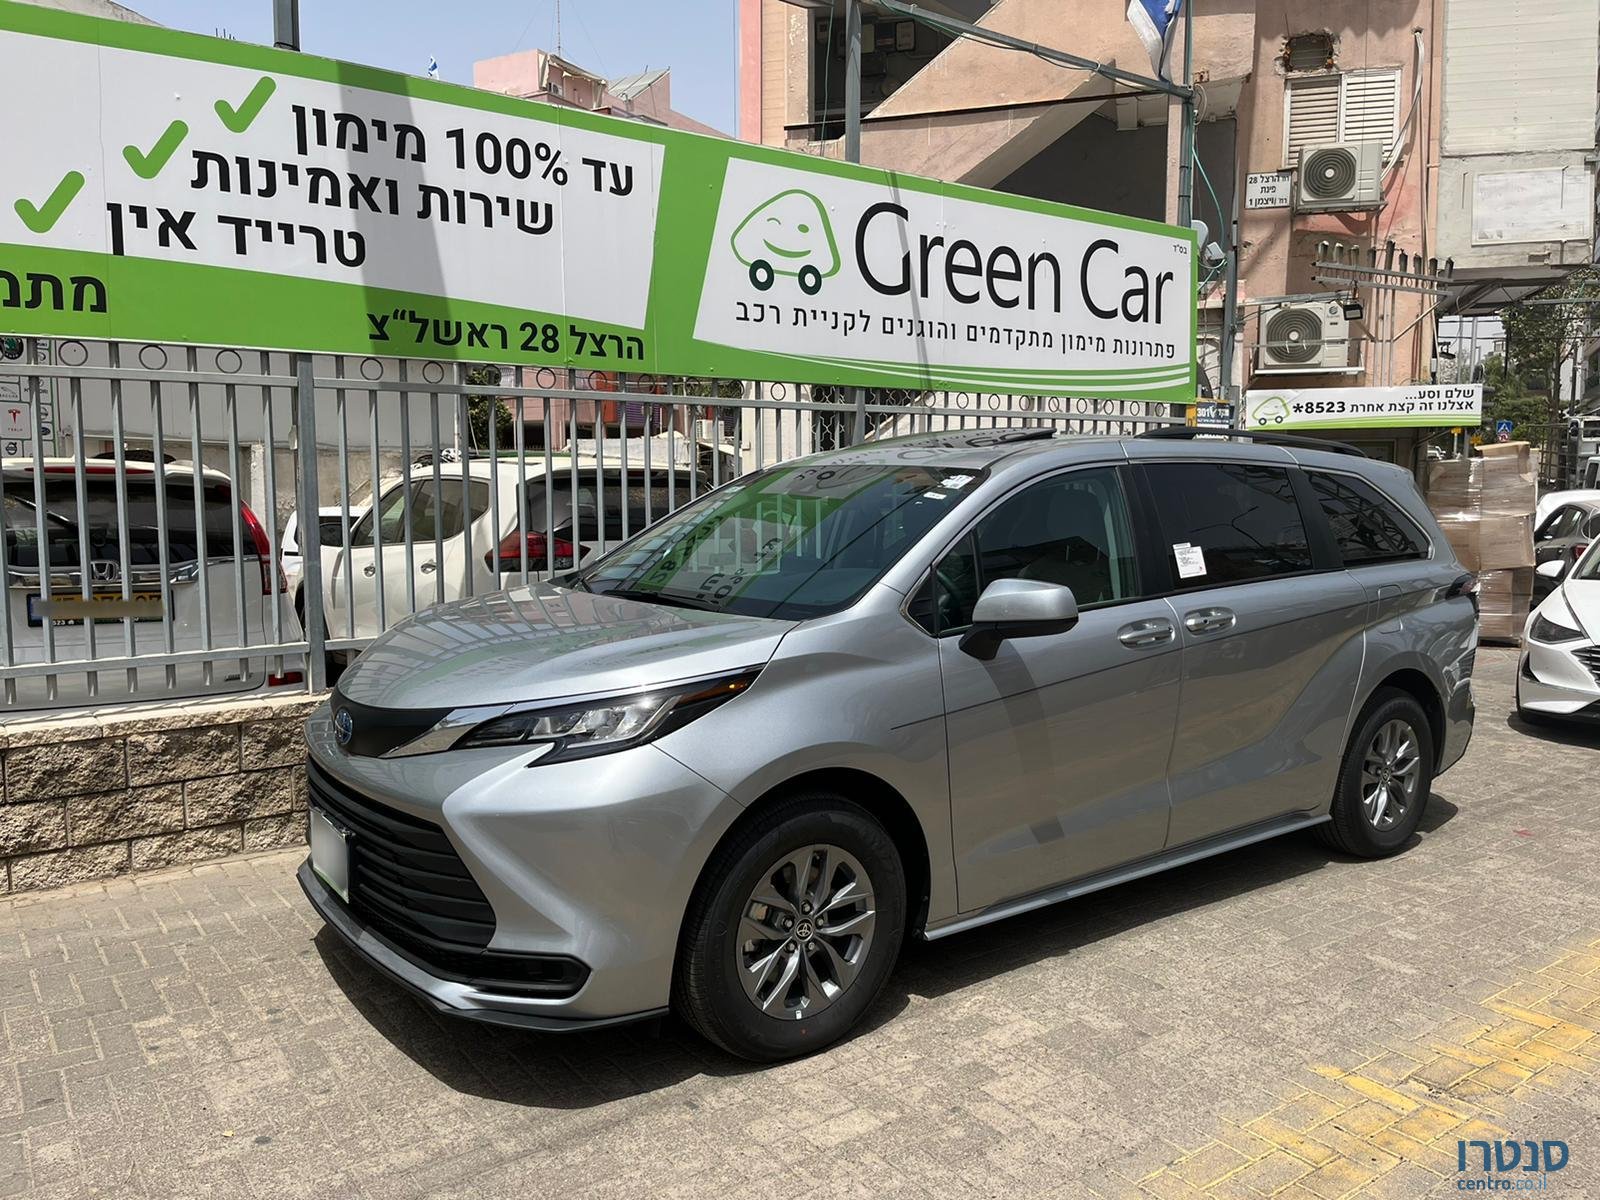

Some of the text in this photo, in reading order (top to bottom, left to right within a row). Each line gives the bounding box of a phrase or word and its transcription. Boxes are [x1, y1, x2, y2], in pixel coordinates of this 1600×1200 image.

[291, 104, 633, 196] עד 100% מימון
[1248, 176, 1258, 184] 28
[1260, 185, 1277, 193] פינת
[190, 150, 553, 235] שירות ואמינות
[106, 202, 366, 268] טרייד אין
[855, 201, 1174, 324] Green Car
[519, 321, 560, 354] 28
[735, 301, 1175, 359] פתרונות מימון מתקדמים והוגנים לקניית רכב
[569, 324, 644, 361] הרצל
[1445, 388, 1474, 399] שלם
[1349, 403, 1384, 413] אחרת
[1387, 402, 1415, 414] קצת
[1419, 402, 1434, 411] זה
[1437, 400, 1474, 412] אצלנו
